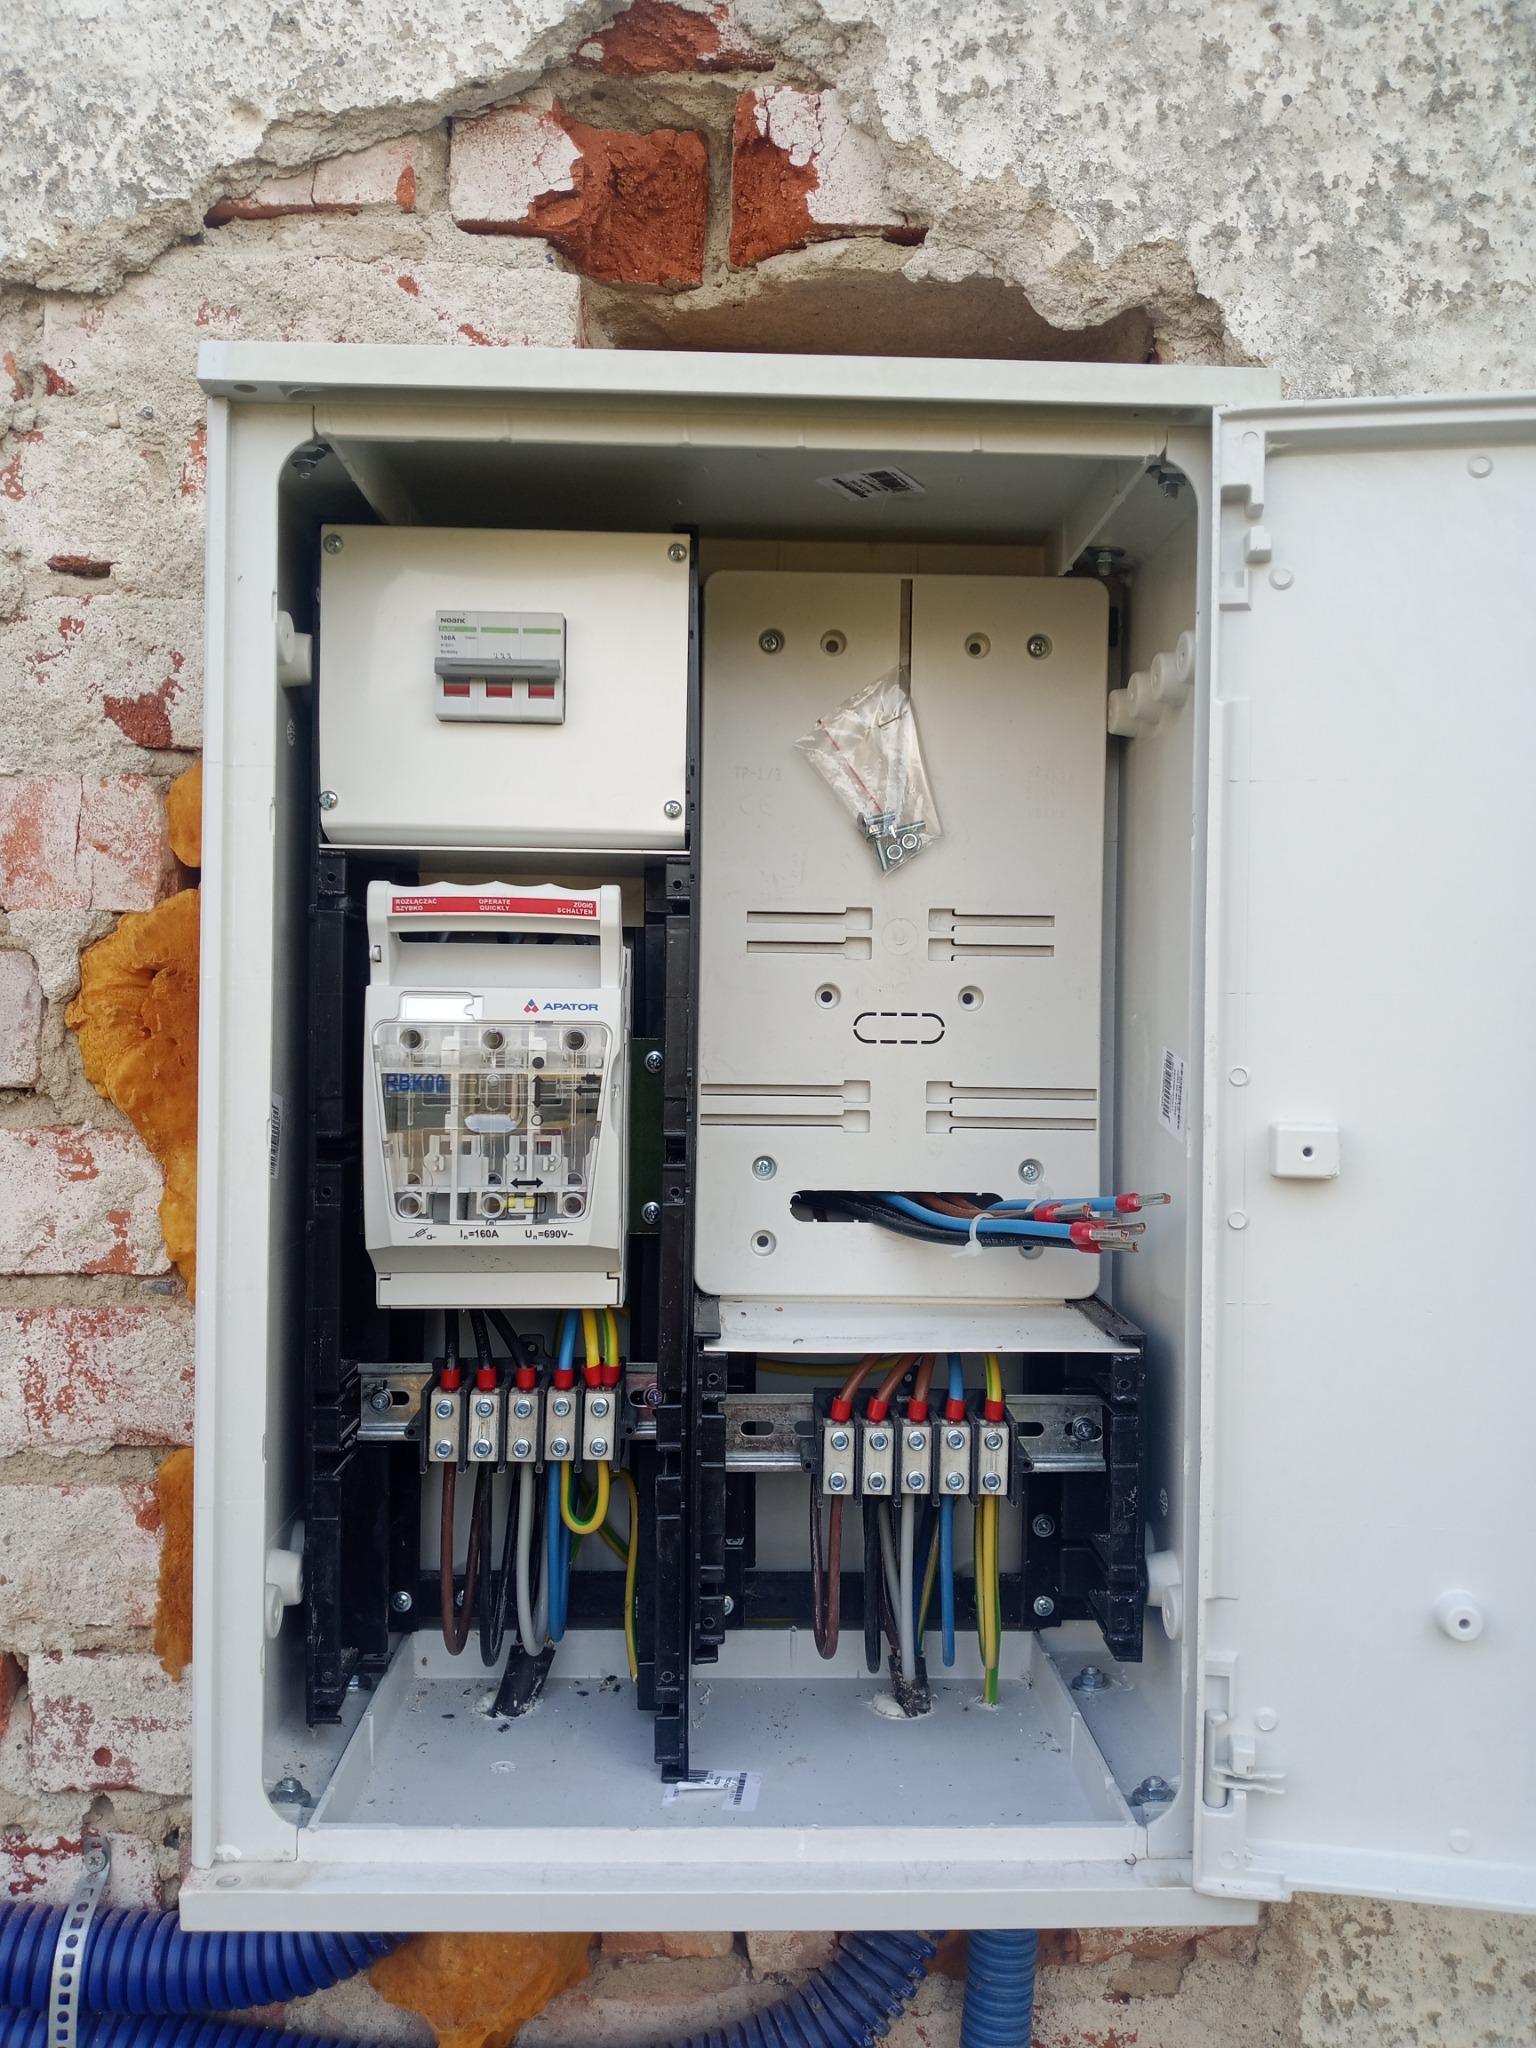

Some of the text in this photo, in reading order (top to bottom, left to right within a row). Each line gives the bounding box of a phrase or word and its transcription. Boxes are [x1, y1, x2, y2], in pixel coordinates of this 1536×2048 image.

[556, 907, 593, 915] SCHALTEN
[543, 1002, 599, 1011] APATOR
[385, 1073, 445, 1093] RBK00
